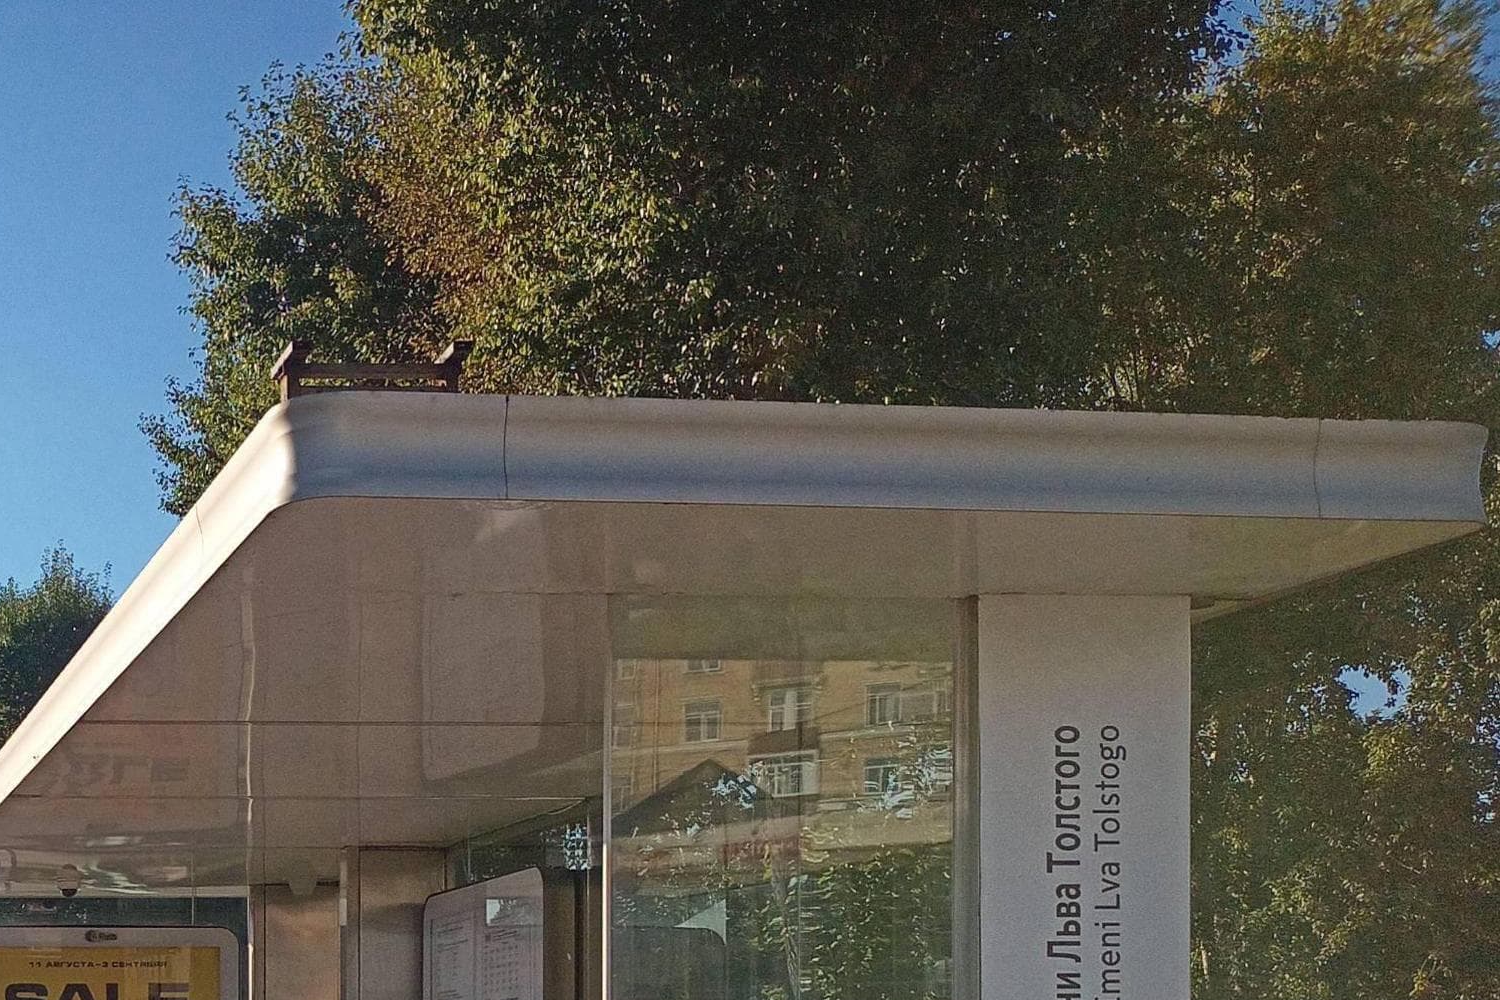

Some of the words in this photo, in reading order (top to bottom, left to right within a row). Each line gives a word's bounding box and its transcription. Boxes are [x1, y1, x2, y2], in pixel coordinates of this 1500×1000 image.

[1046, 725, 1081, 874] Толстого
[1093, 725, 1127, 853] Tolstogo
[1046, 883, 1082, 963] Льва
[1094, 861, 1121, 910] Lva
